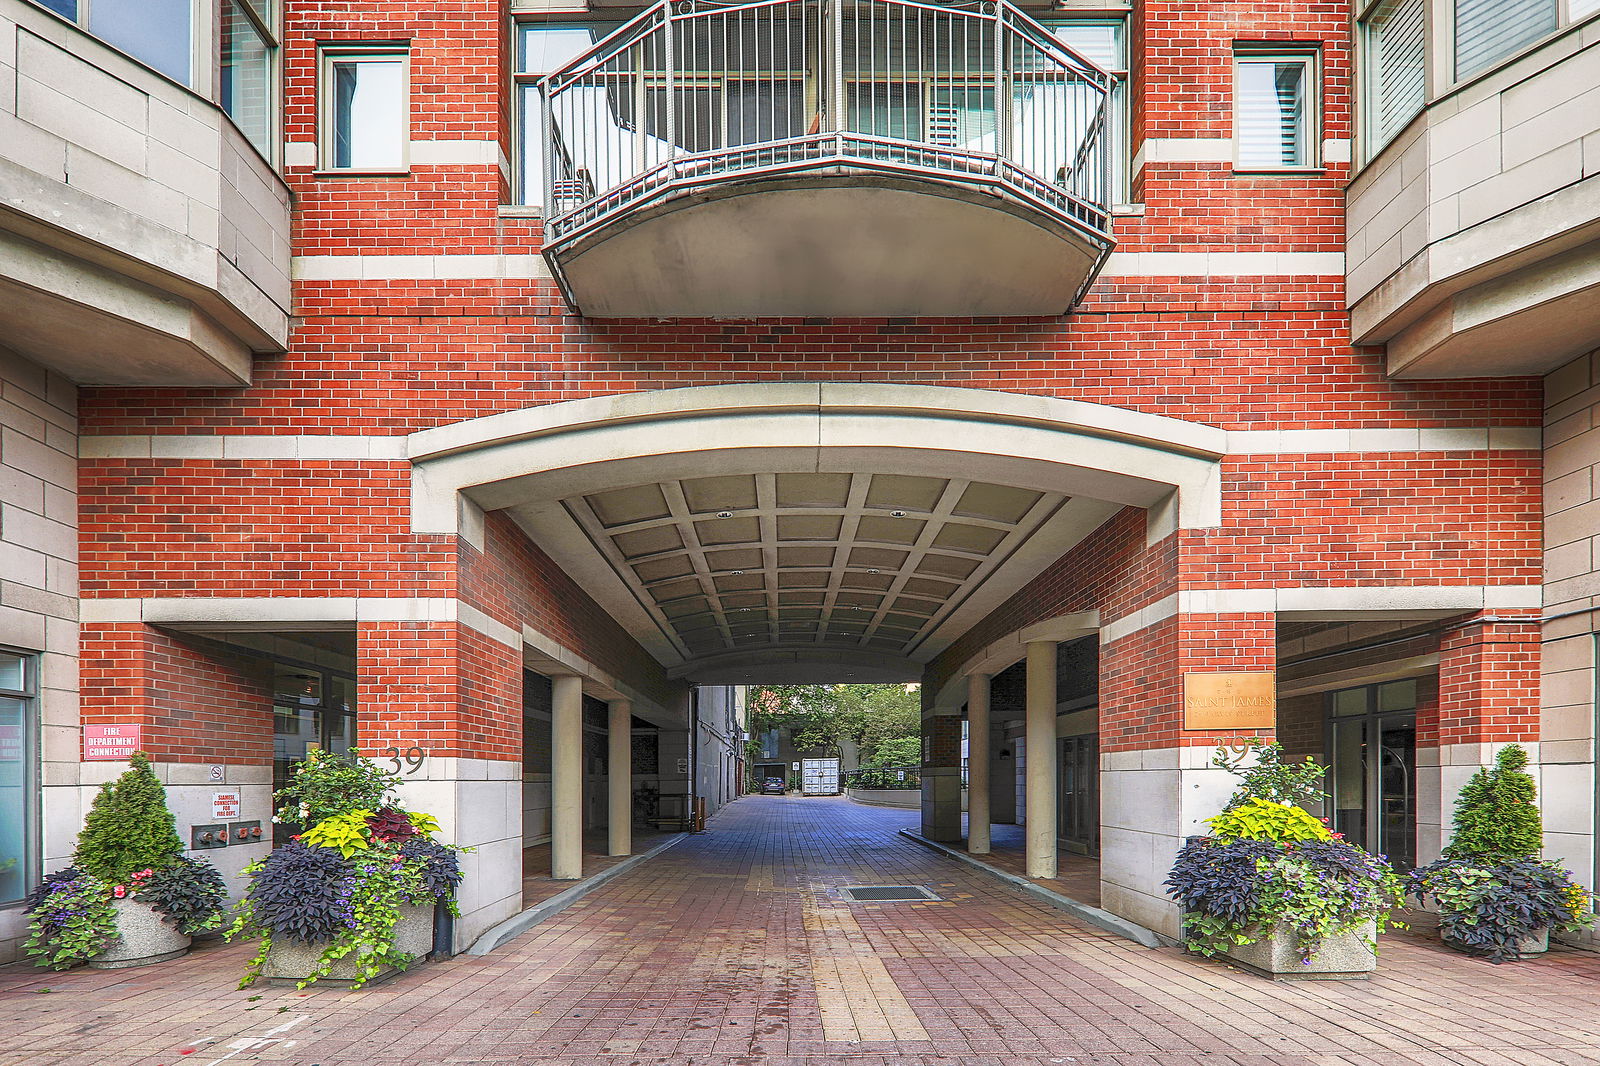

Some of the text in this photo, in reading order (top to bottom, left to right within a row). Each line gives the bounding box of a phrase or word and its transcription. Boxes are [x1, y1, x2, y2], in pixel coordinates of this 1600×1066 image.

[1187, 695, 1272, 709] SAINT JAMES
[103, 727, 121, 736] FIRE
[88, 737, 136, 746] DEPARTMENT
[1211, 735, 1249, 763] 39
[385, 746, 425, 776] 39
